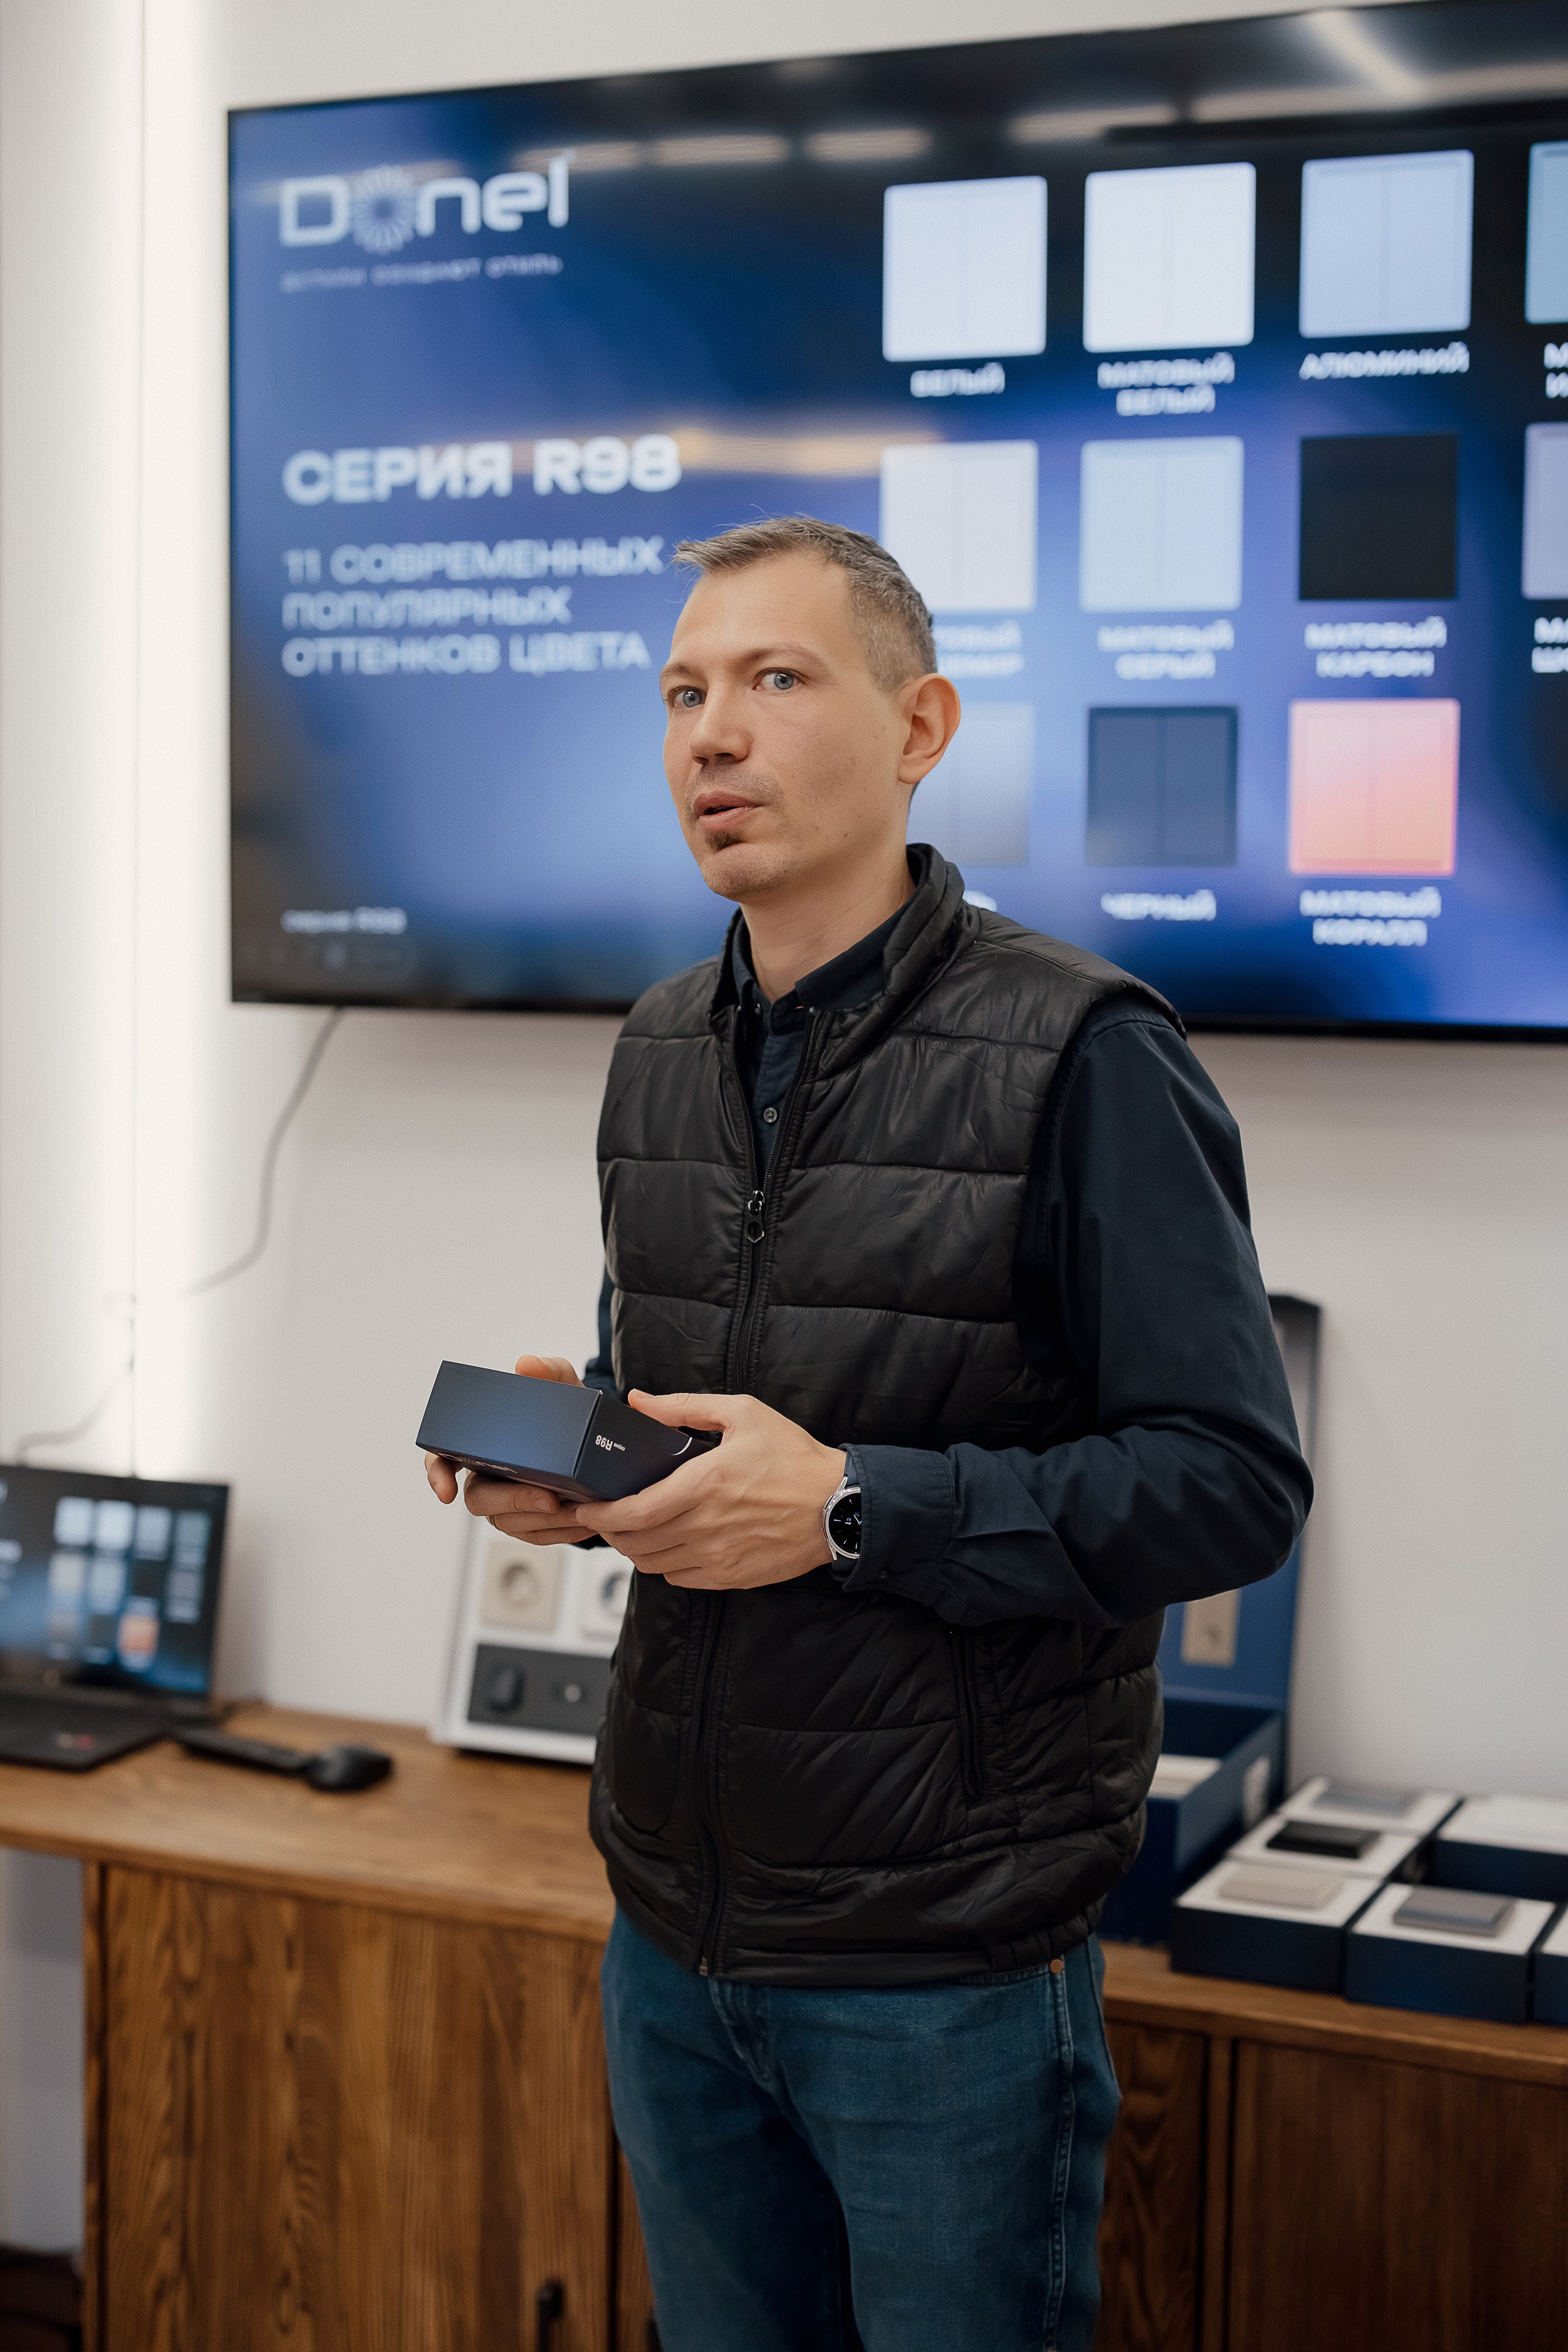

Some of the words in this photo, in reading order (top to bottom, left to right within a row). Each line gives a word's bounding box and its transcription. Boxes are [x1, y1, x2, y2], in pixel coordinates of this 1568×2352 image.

[911, 362, 1005, 396] БЕЛЫЙ
[1098, 352, 1235, 388] МАТОВЫЙ
[1298, 342, 1469, 380] АЛЮМИНИЙ
[284, 442, 512, 503] СЕРИЯ
[533, 435, 681, 494] R98
[284, 548, 321, 584] 11
[330, 536, 665, 584] СОВРЕМЕННЫХ
[282, 586, 571, 630] ПОПУЛЯРНЫХ
[1305, 616, 1447, 649] МАТОВЫЙ
[282, 635, 500, 676] ОТТЕНКОВ
[510, 632, 650, 676] ЦВЕТА
[1300, 887, 1441, 918] МАТОВЫЙ
[595, 1434, 613, 1452] R98
